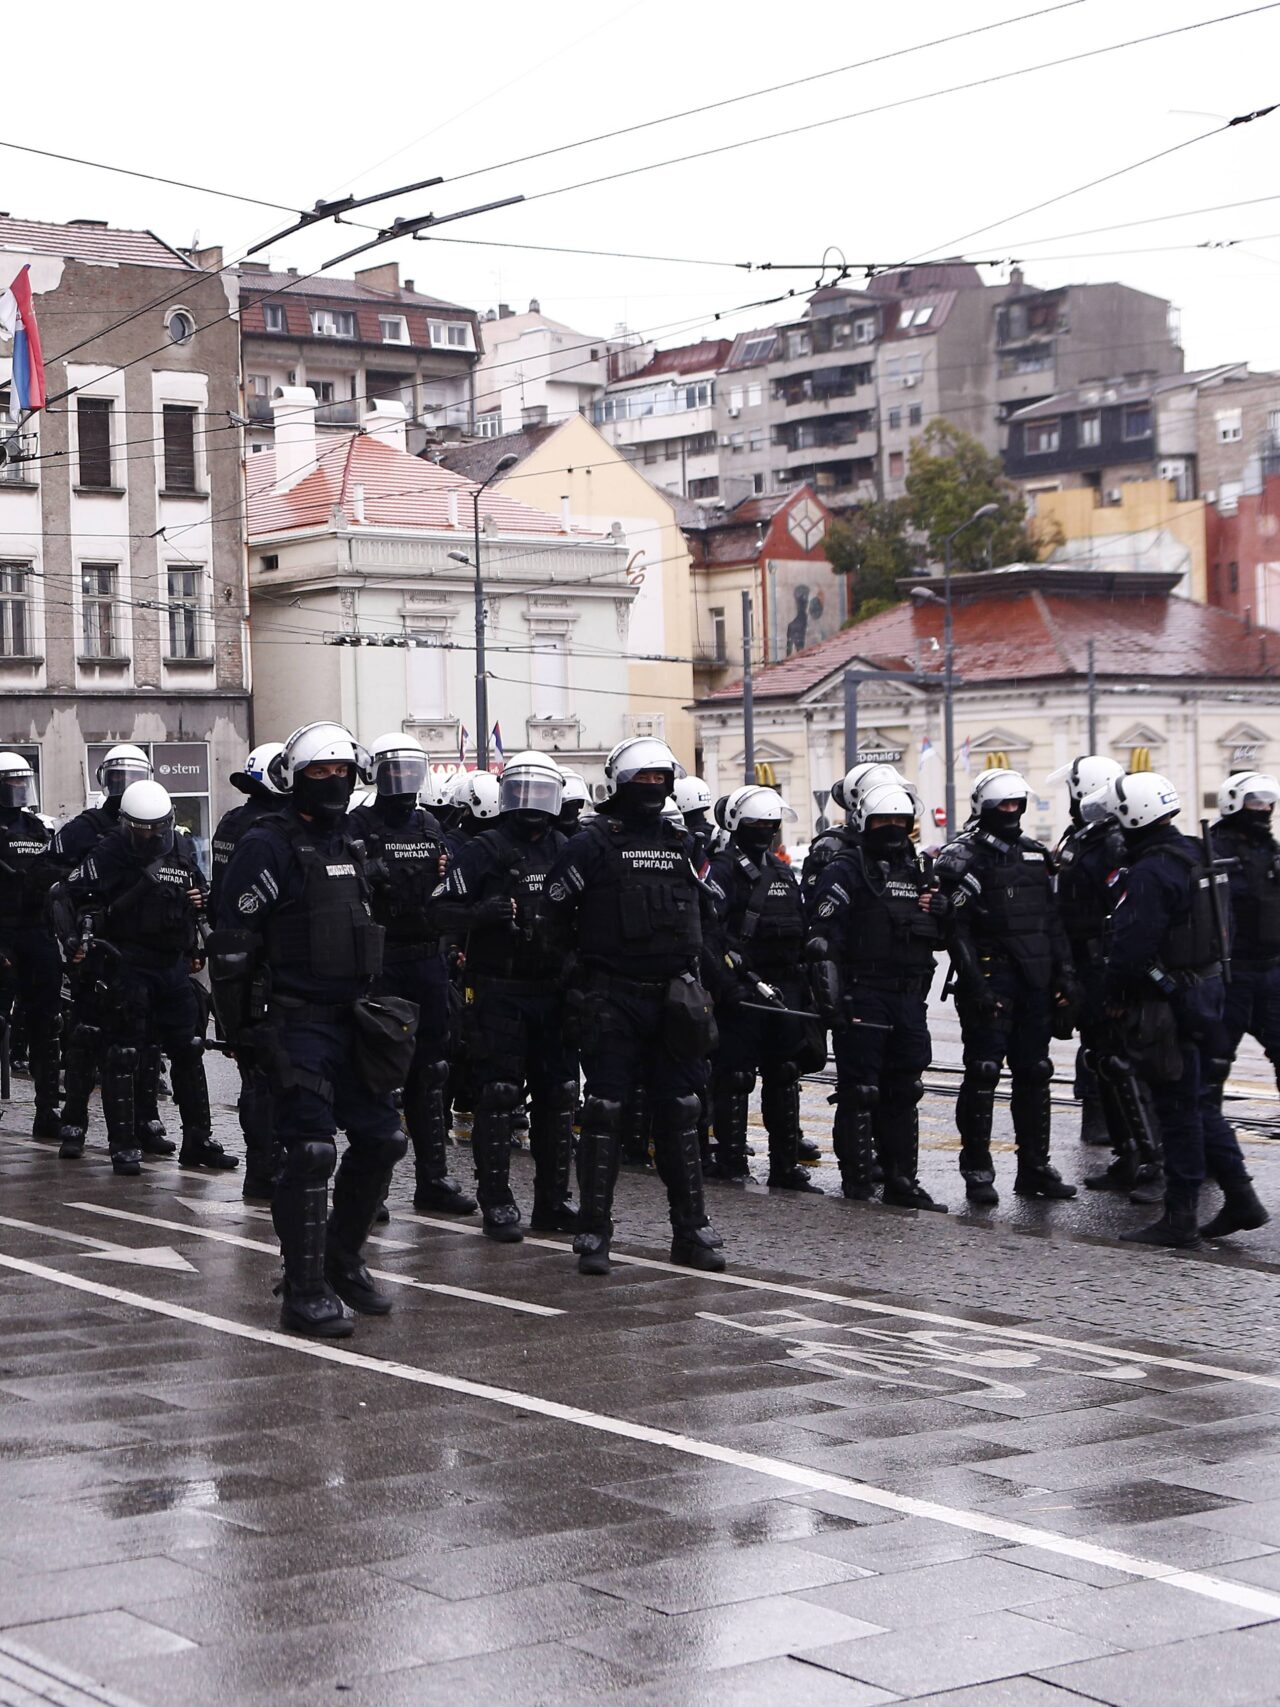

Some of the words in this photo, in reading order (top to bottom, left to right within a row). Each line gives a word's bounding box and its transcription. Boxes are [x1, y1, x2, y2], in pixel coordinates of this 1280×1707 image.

[172, 763, 200, 774] stem
[385, 842, 436, 851] ПОЛИЦИЈСКА
[394, 850, 429, 858] БРИГАДА
[622, 850, 682, 860] ПОЛИЦИЈСКА
[633, 860, 674, 870] БРИГАДА
